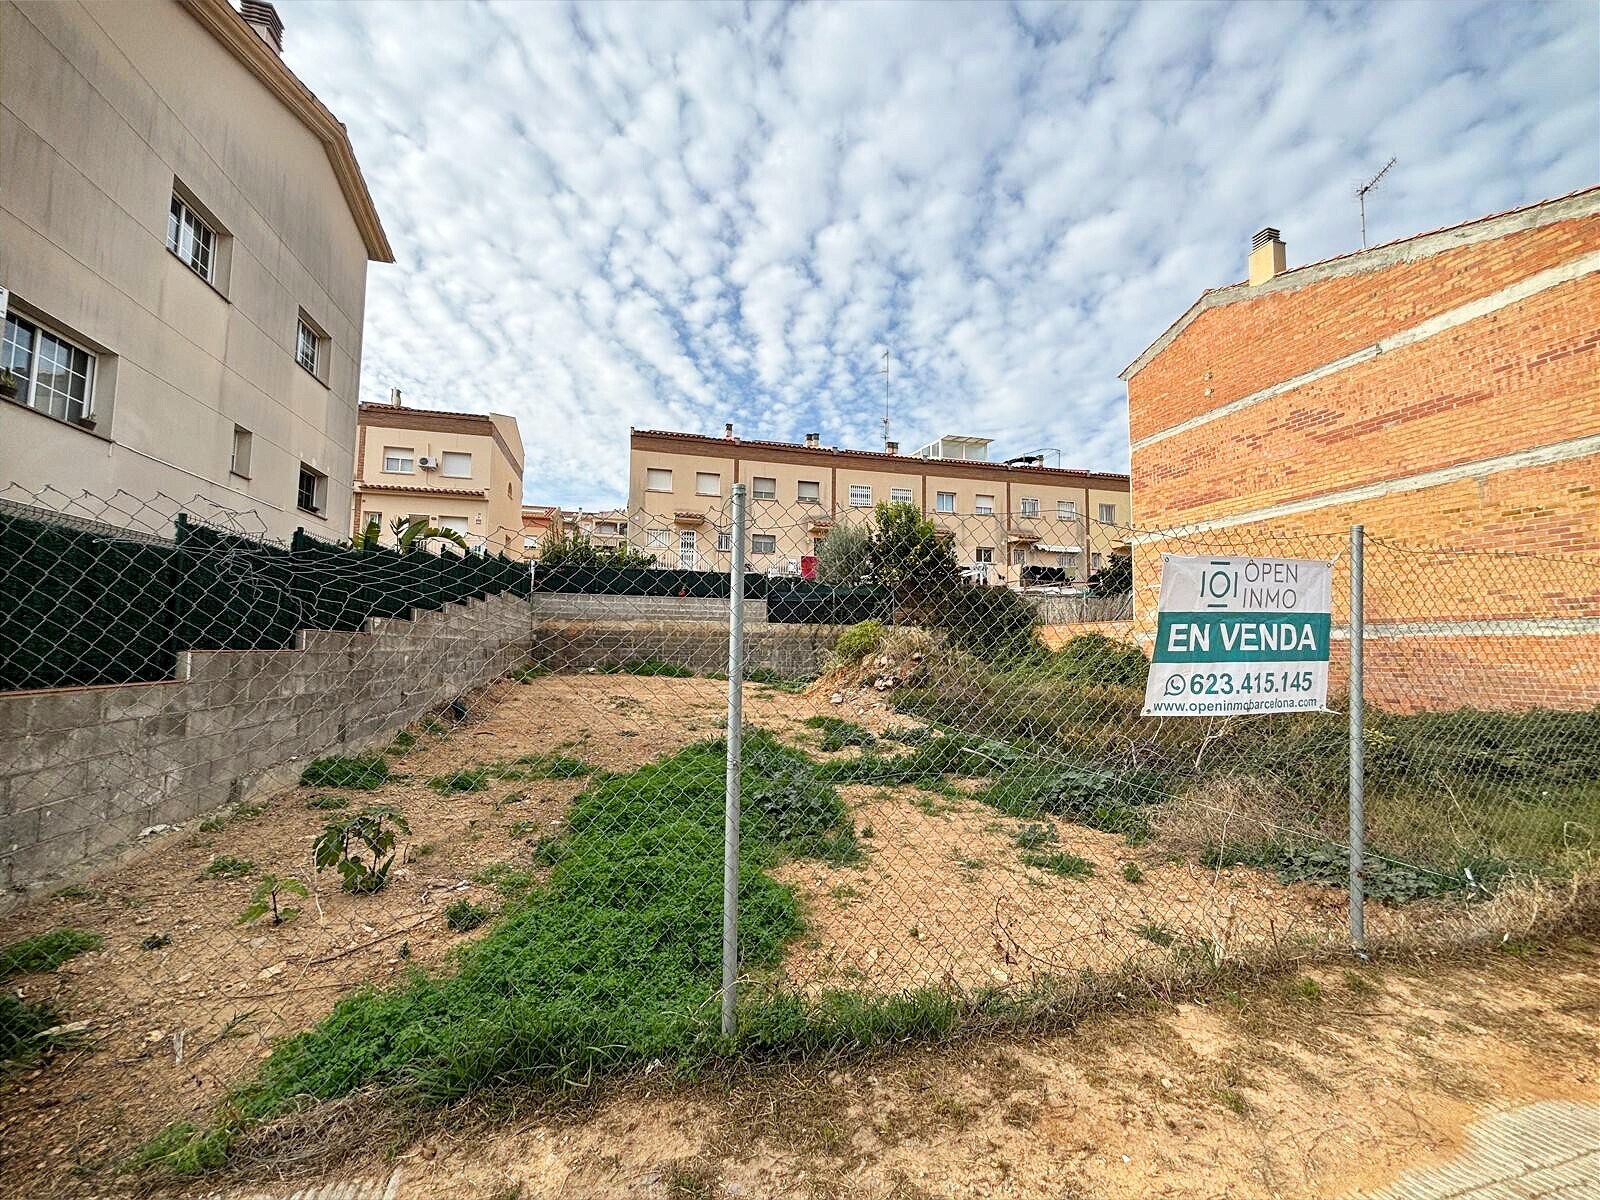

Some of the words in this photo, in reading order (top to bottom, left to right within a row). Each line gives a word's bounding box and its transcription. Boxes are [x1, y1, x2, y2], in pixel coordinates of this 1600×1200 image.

[1244, 562, 1298, 584] OPEN
[1242, 587, 1297, 609] INMO
[1167, 623, 1211, 652] EN
[1219, 623, 1317, 651] VENDA
[1189, 671, 1313, 695] 623.415.145
